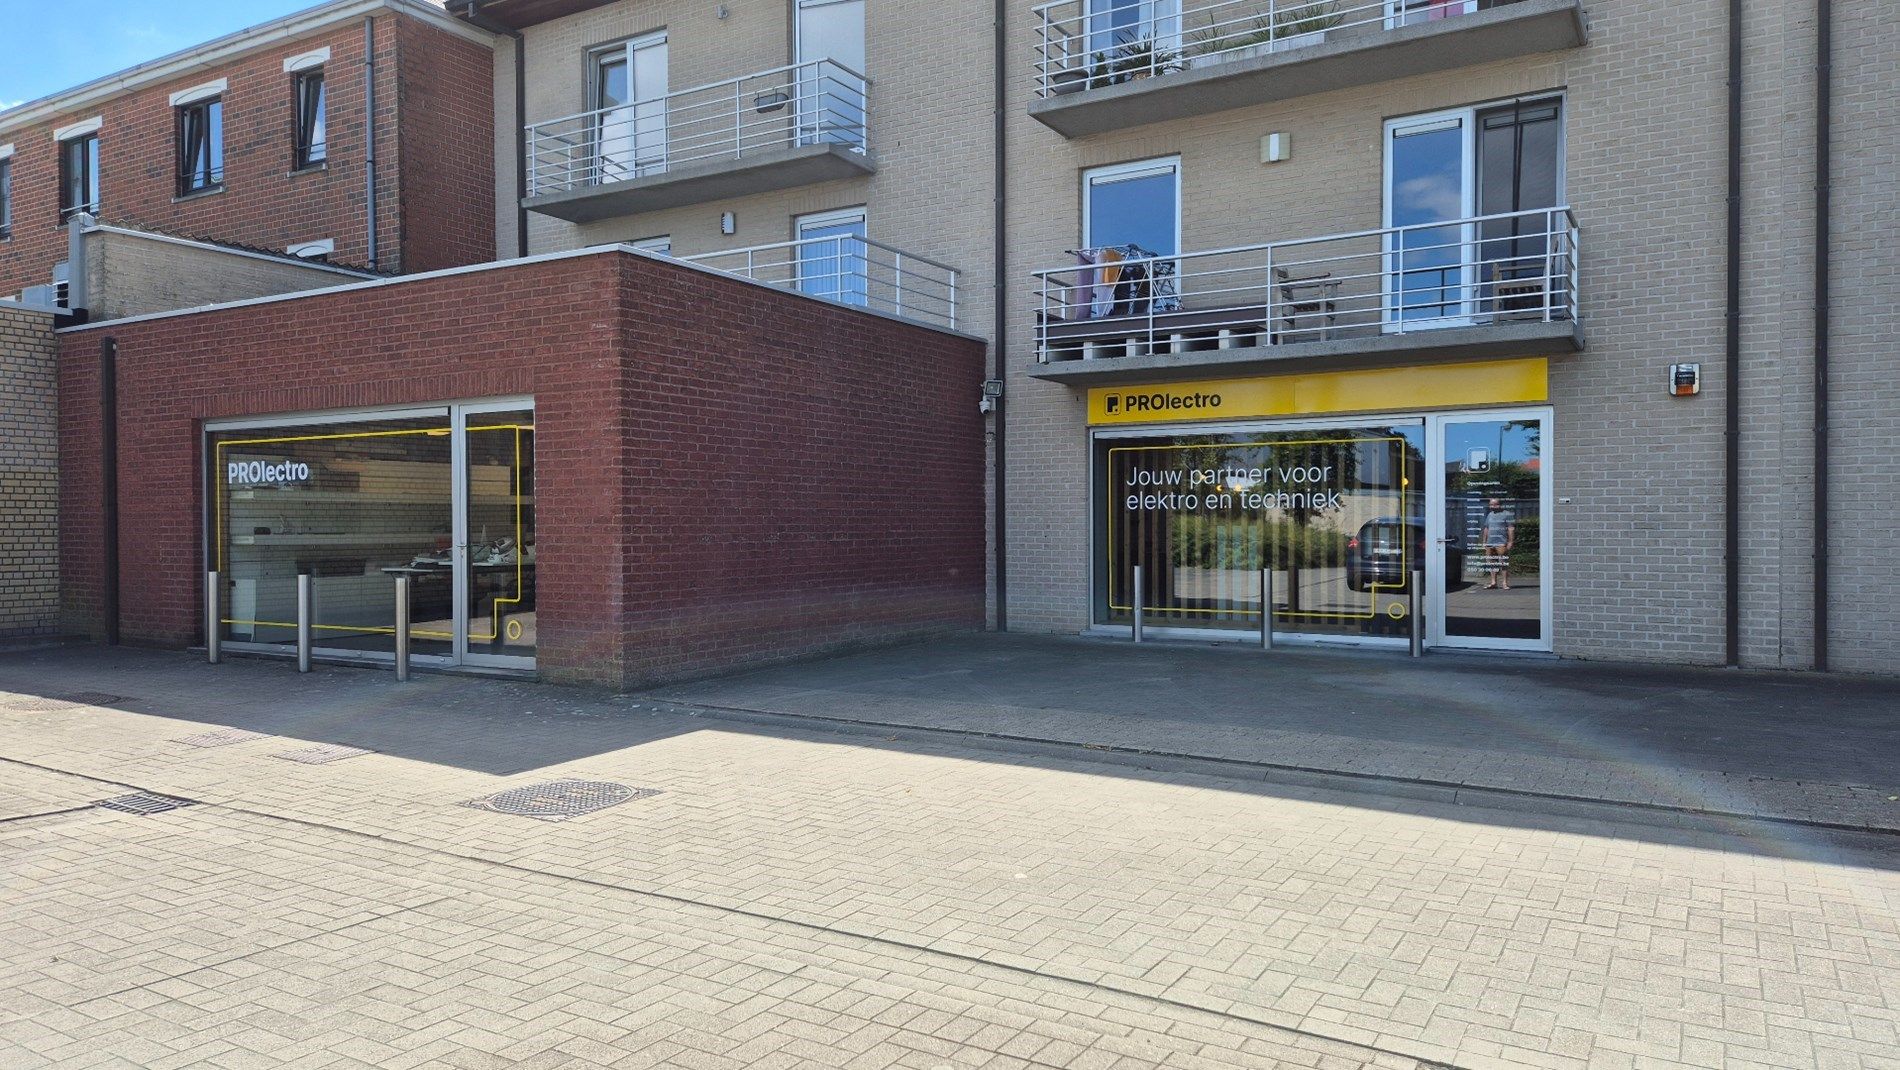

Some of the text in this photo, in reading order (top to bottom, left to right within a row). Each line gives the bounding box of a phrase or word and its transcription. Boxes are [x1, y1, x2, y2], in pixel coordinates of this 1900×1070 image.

[1125, 392, 1222, 412] PROlectro
[228, 460, 309, 484] PROlectro
[1126, 465, 1333, 490] Jouw partner voor
[1126, 488, 1341, 510] elektro en techniek
